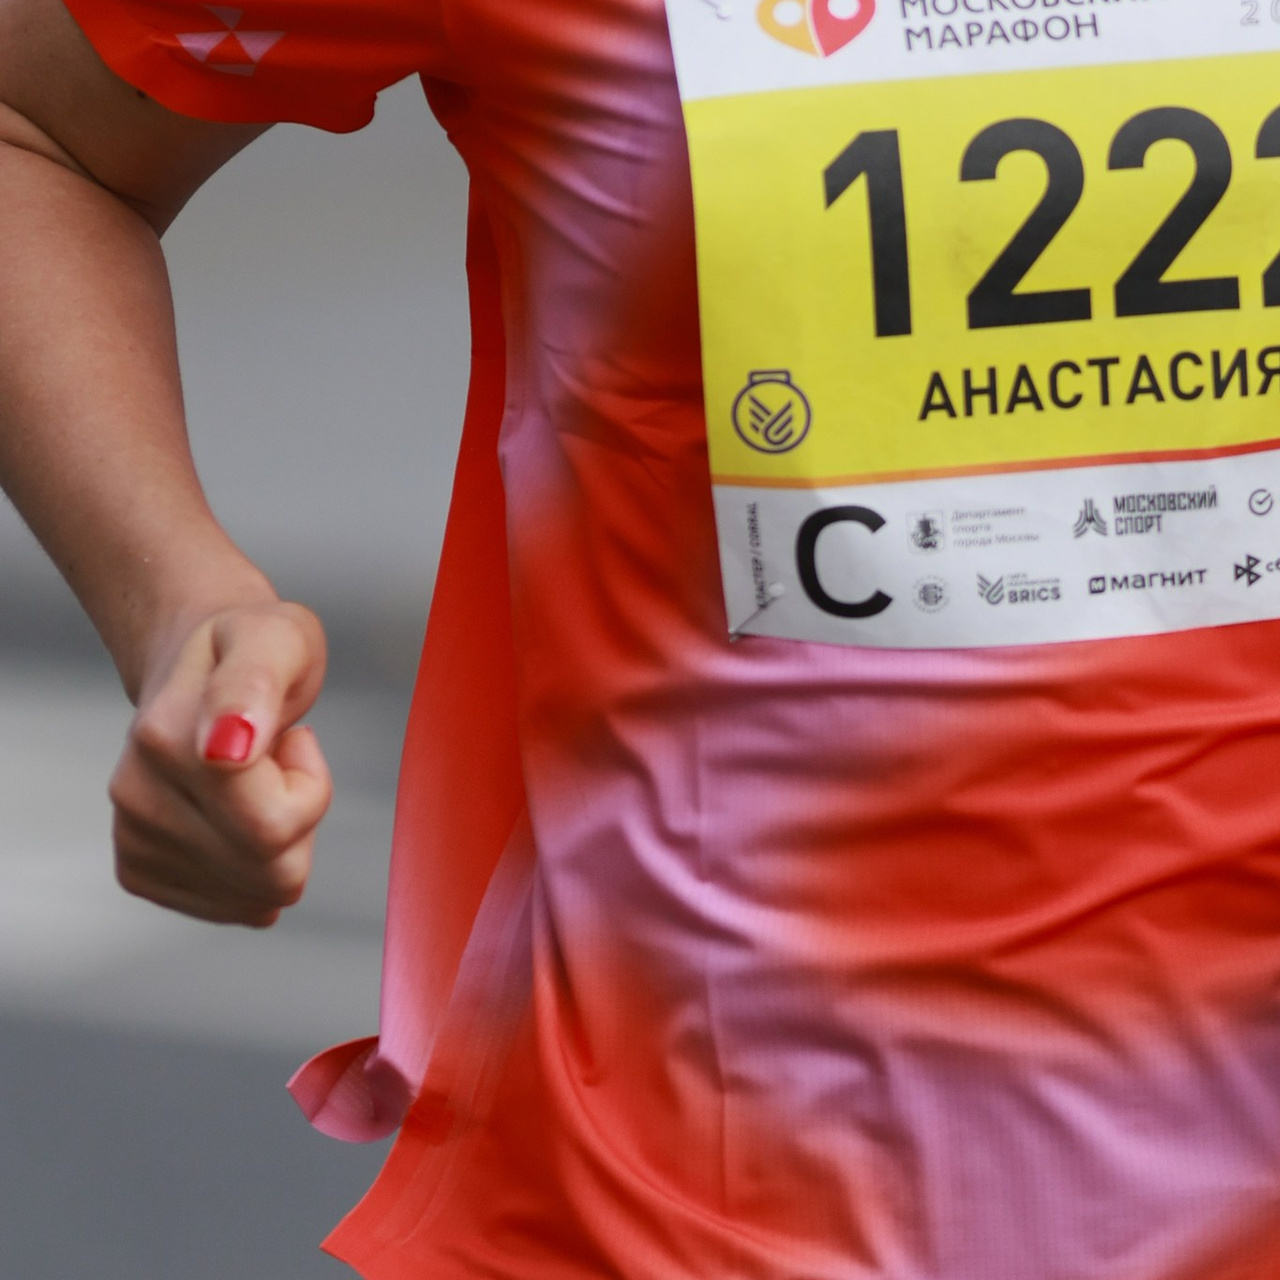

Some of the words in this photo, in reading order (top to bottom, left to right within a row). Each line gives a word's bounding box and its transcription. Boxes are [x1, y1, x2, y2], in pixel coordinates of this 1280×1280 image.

[906, 12, 1100, 51] МАРАФОН
[1113, 485, 1219, 514] МОСКОВСКИЙ
[1114, 514, 1164, 536] СПОРТ
[1111, 568, 1208, 591] магнит
[1008, 586, 1061, 603] BRICS
